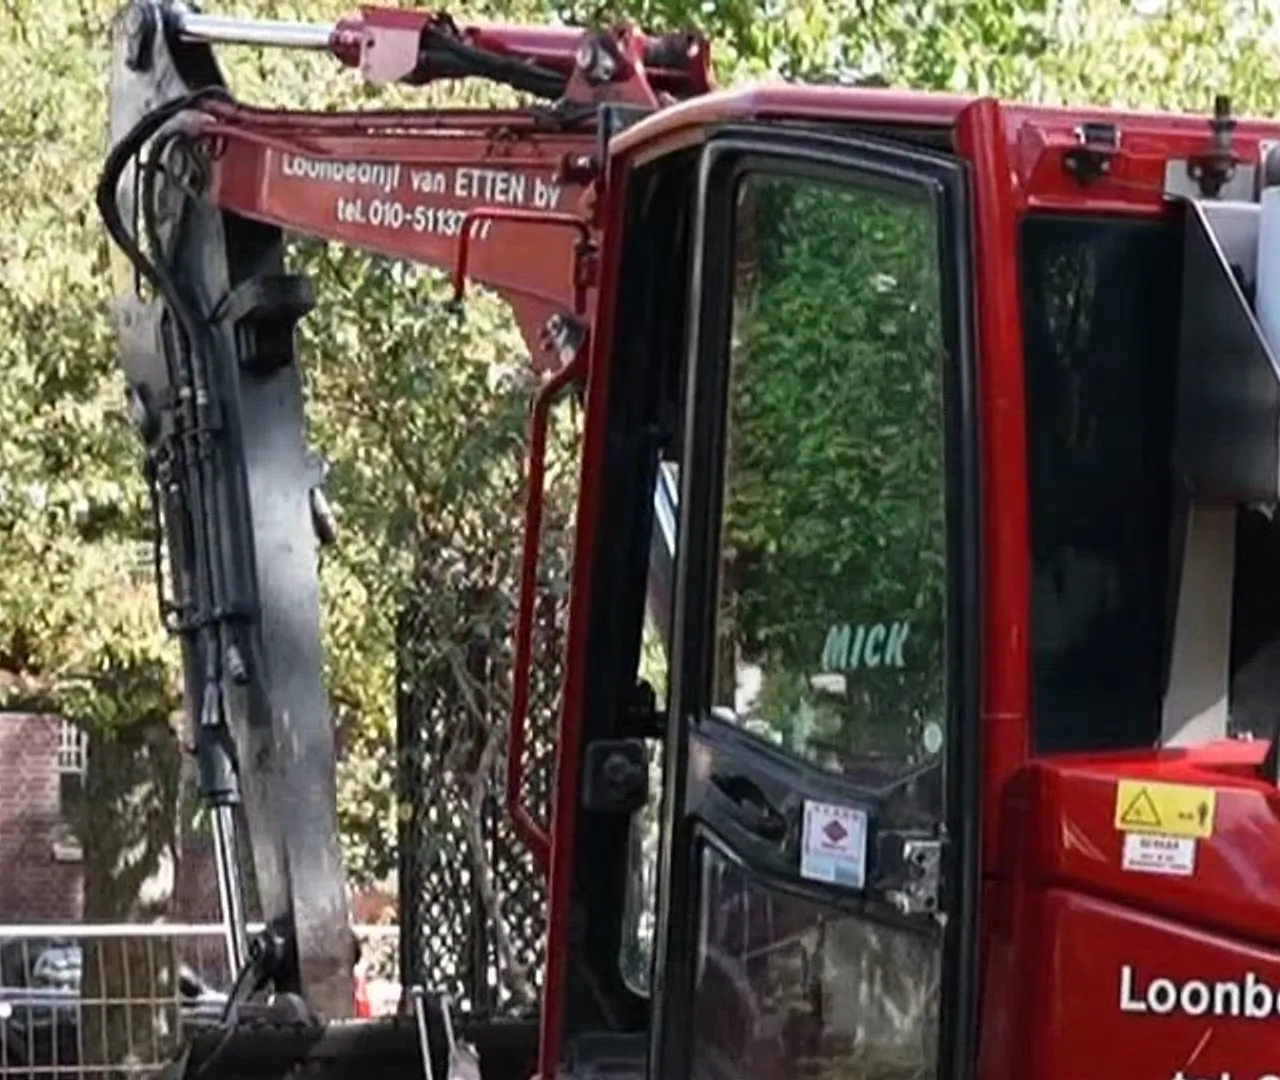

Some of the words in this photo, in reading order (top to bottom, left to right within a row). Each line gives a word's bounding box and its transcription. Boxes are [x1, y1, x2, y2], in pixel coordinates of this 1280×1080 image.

[410, 169, 446, 194] van
[455, 167, 525, 204] ETTEN
[533, 174, 561, 209] bv
[822, 621, 910, 671] MICK
